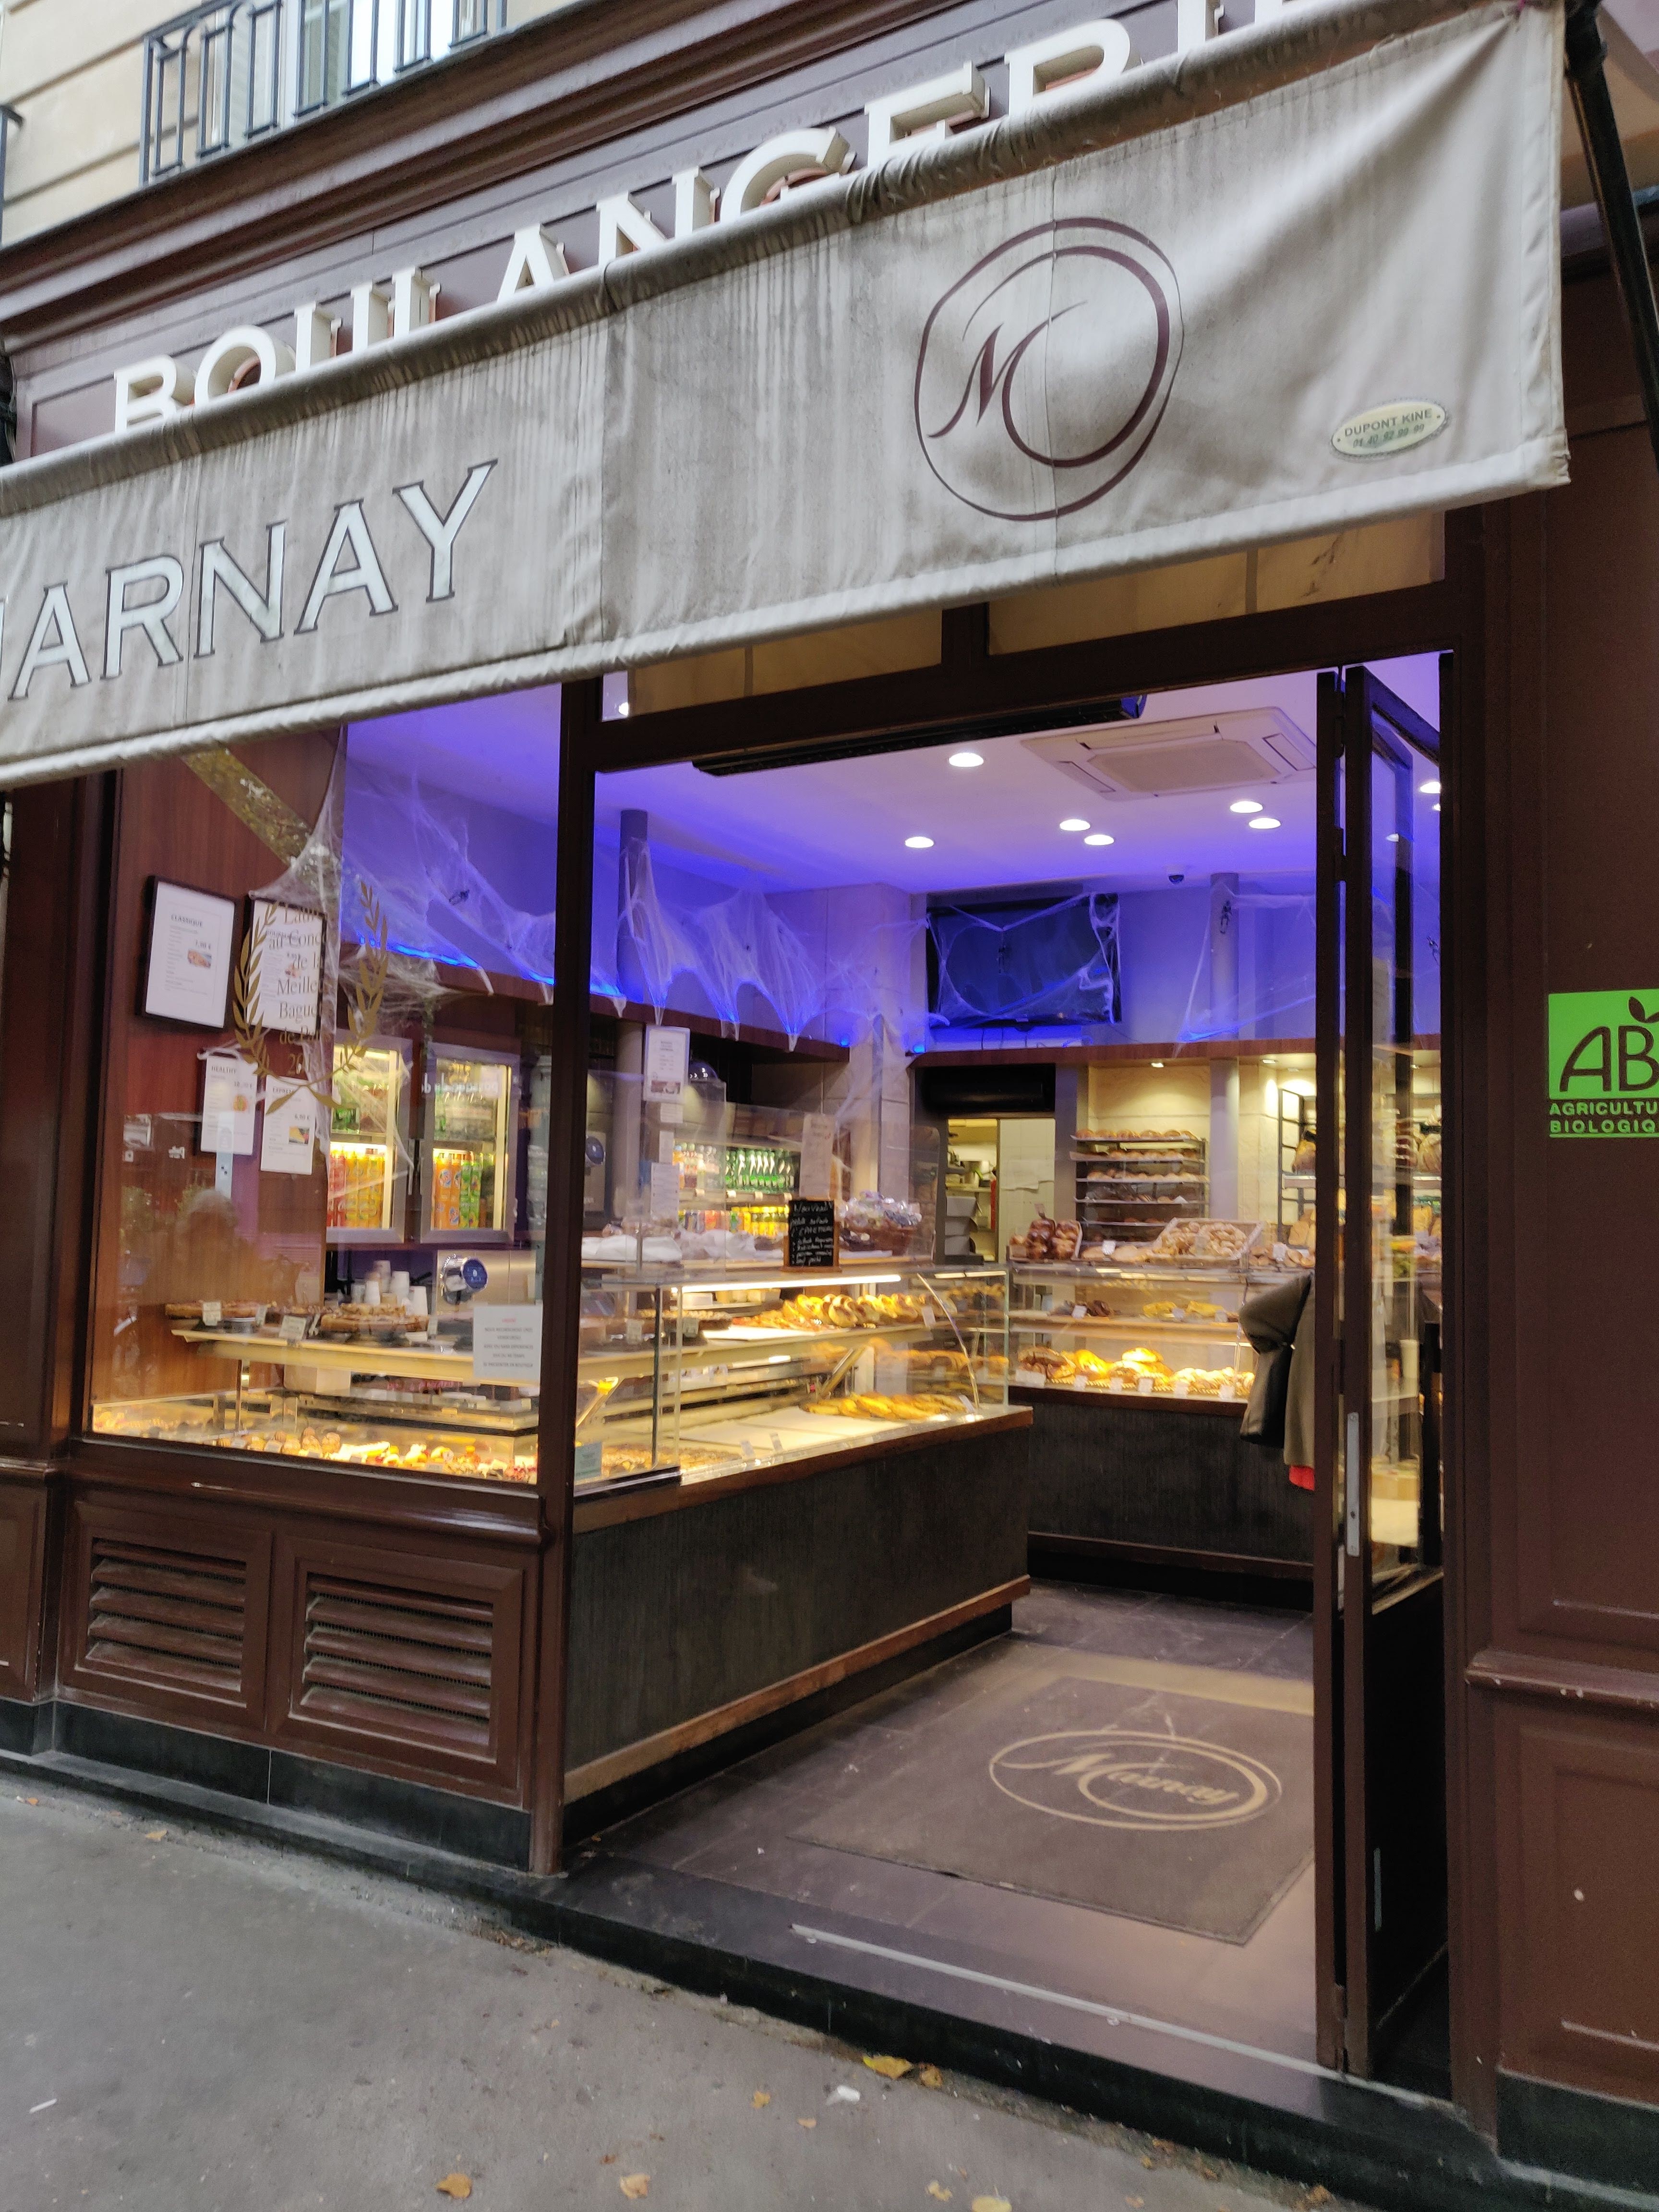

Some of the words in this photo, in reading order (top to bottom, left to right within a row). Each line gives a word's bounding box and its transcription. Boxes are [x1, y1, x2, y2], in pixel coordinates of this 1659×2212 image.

[114, 0, 1330, 432] BOULANGERI
[1345, 416, 1397, 437] DUPONT
[1402, 408, 1432, 424] KINE
[0, 459, 498, 701] ARNAY
[277, 976, 324, 996] Meille
[279, 1001, 323, 1023] Bague
[1559, 1024, 1659, 1093] AB
[211, 1066, 237, 1074] HEALTHY
[1550, 1101, 1658, 1116] AGRICULTU
[1550, 1119, 1659, 1133] BIOLOGIQ
